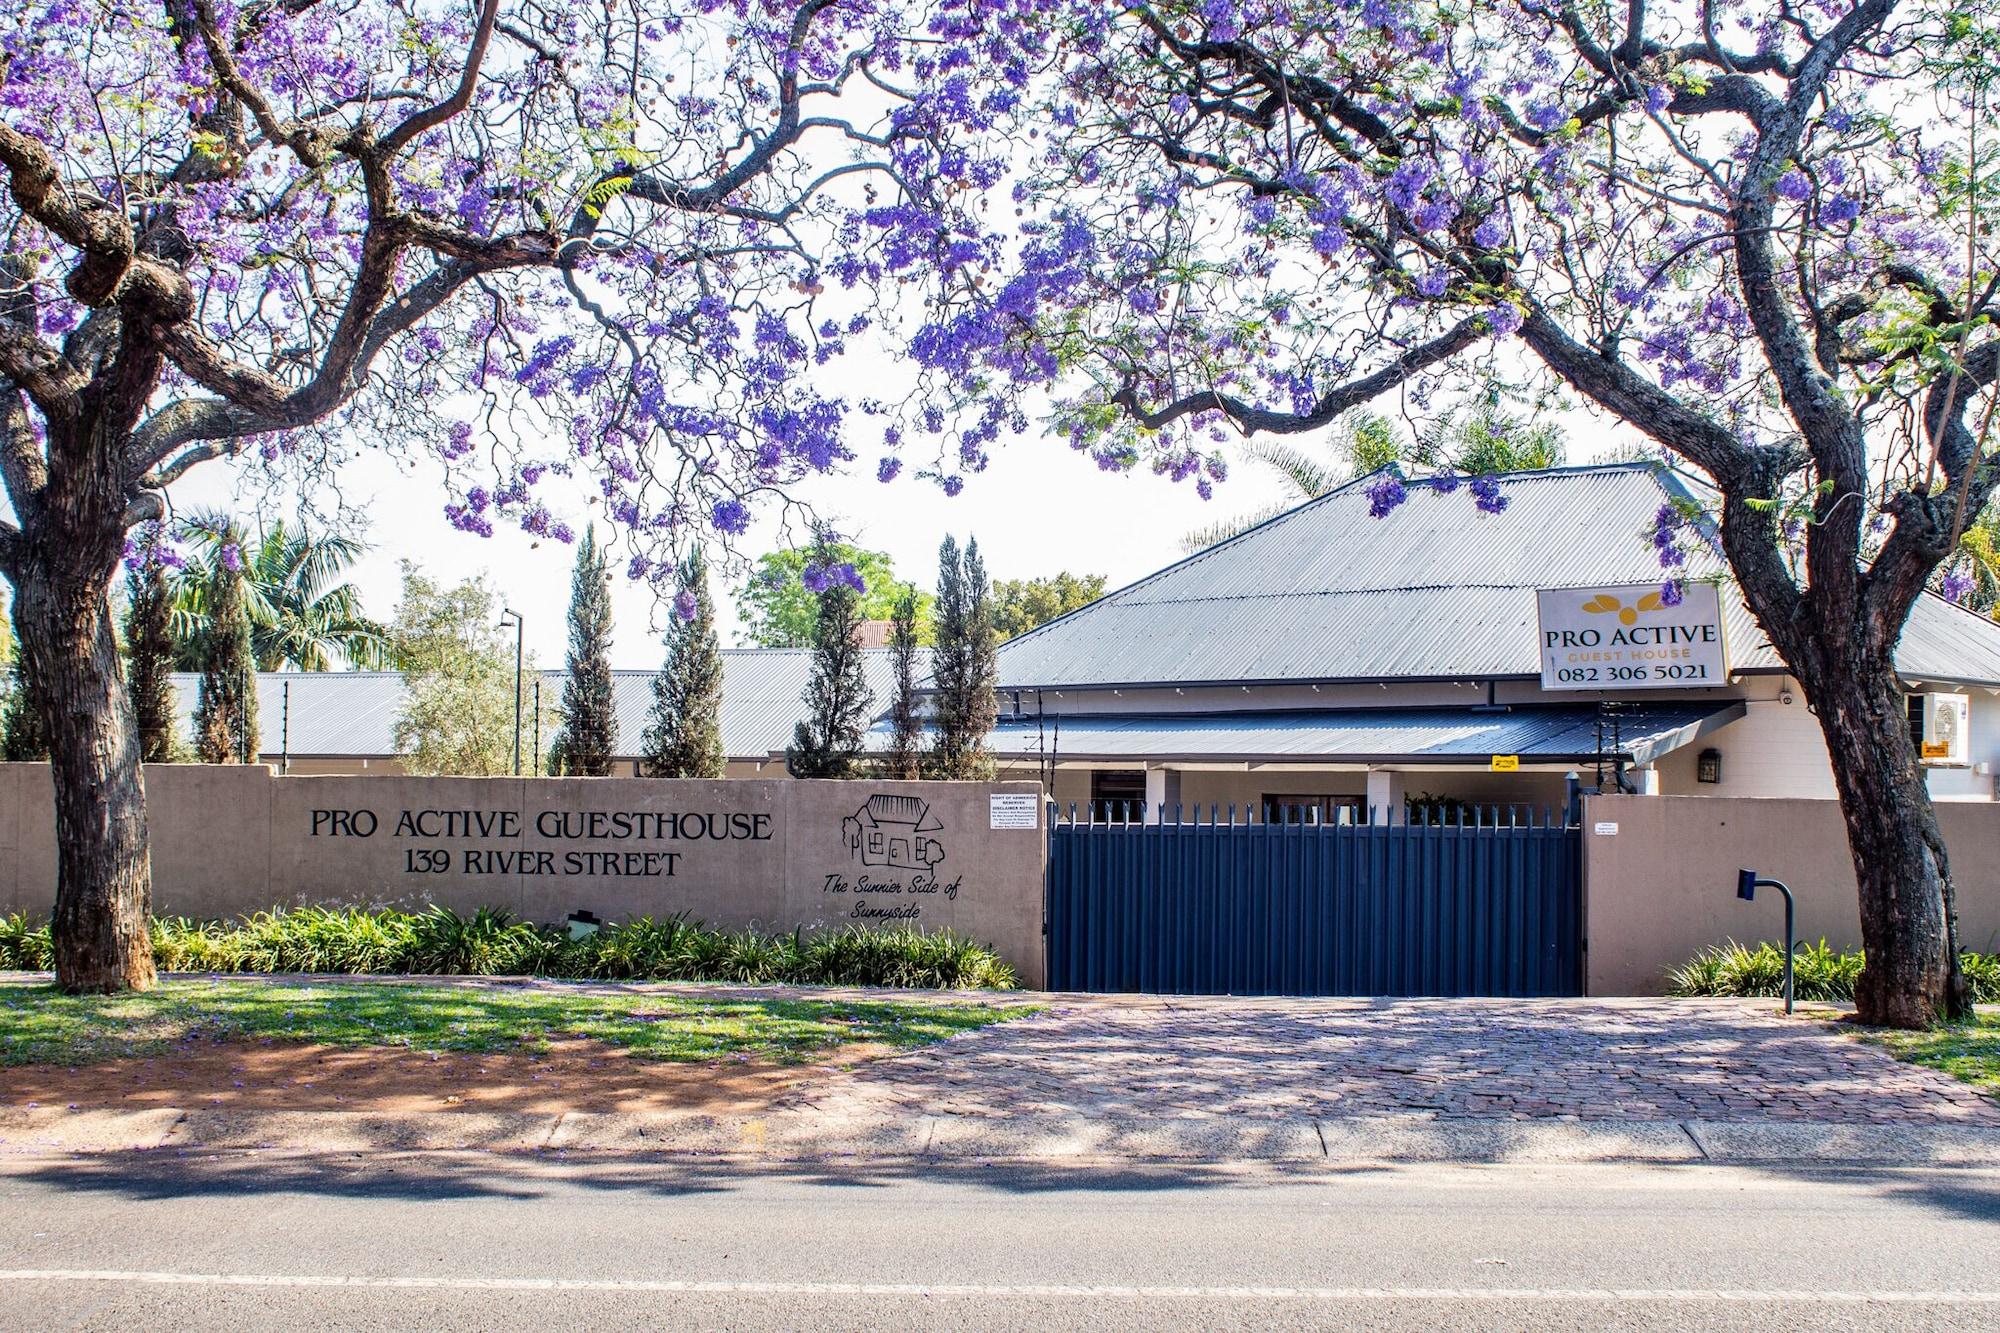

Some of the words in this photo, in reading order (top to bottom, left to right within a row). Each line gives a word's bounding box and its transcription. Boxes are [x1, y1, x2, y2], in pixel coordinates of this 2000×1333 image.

[1545, 630, 1601, 648] PRO
[1610, 624, 1717, 646] ACTIVE
[1568, 651, 1623, 663] GUEST
[1631, 648, 1691, 661] HOUSE
[1558, 668, 1599, 682] 082
[1607, 666, 1647, 680] 306
[1654, 664, 1708, 679] 5021
[310, 809, 379, 838] PRO
[392, 810, 522, 838] ACTIVE
[536, 811, 774, 841] GUESTHOUSE
[404, 848, 451, 874] 139
[462, 850, 557, 875] RIVER
[563, 851, 682, 877] STREET
[824, 874, 848, 894] The
[854, 875, 902, 894] Sunnier
[908, 875, 939, 894] Side
[944, 875, 963, 900] of
[850, 900, 921, 926] Sunnyside
